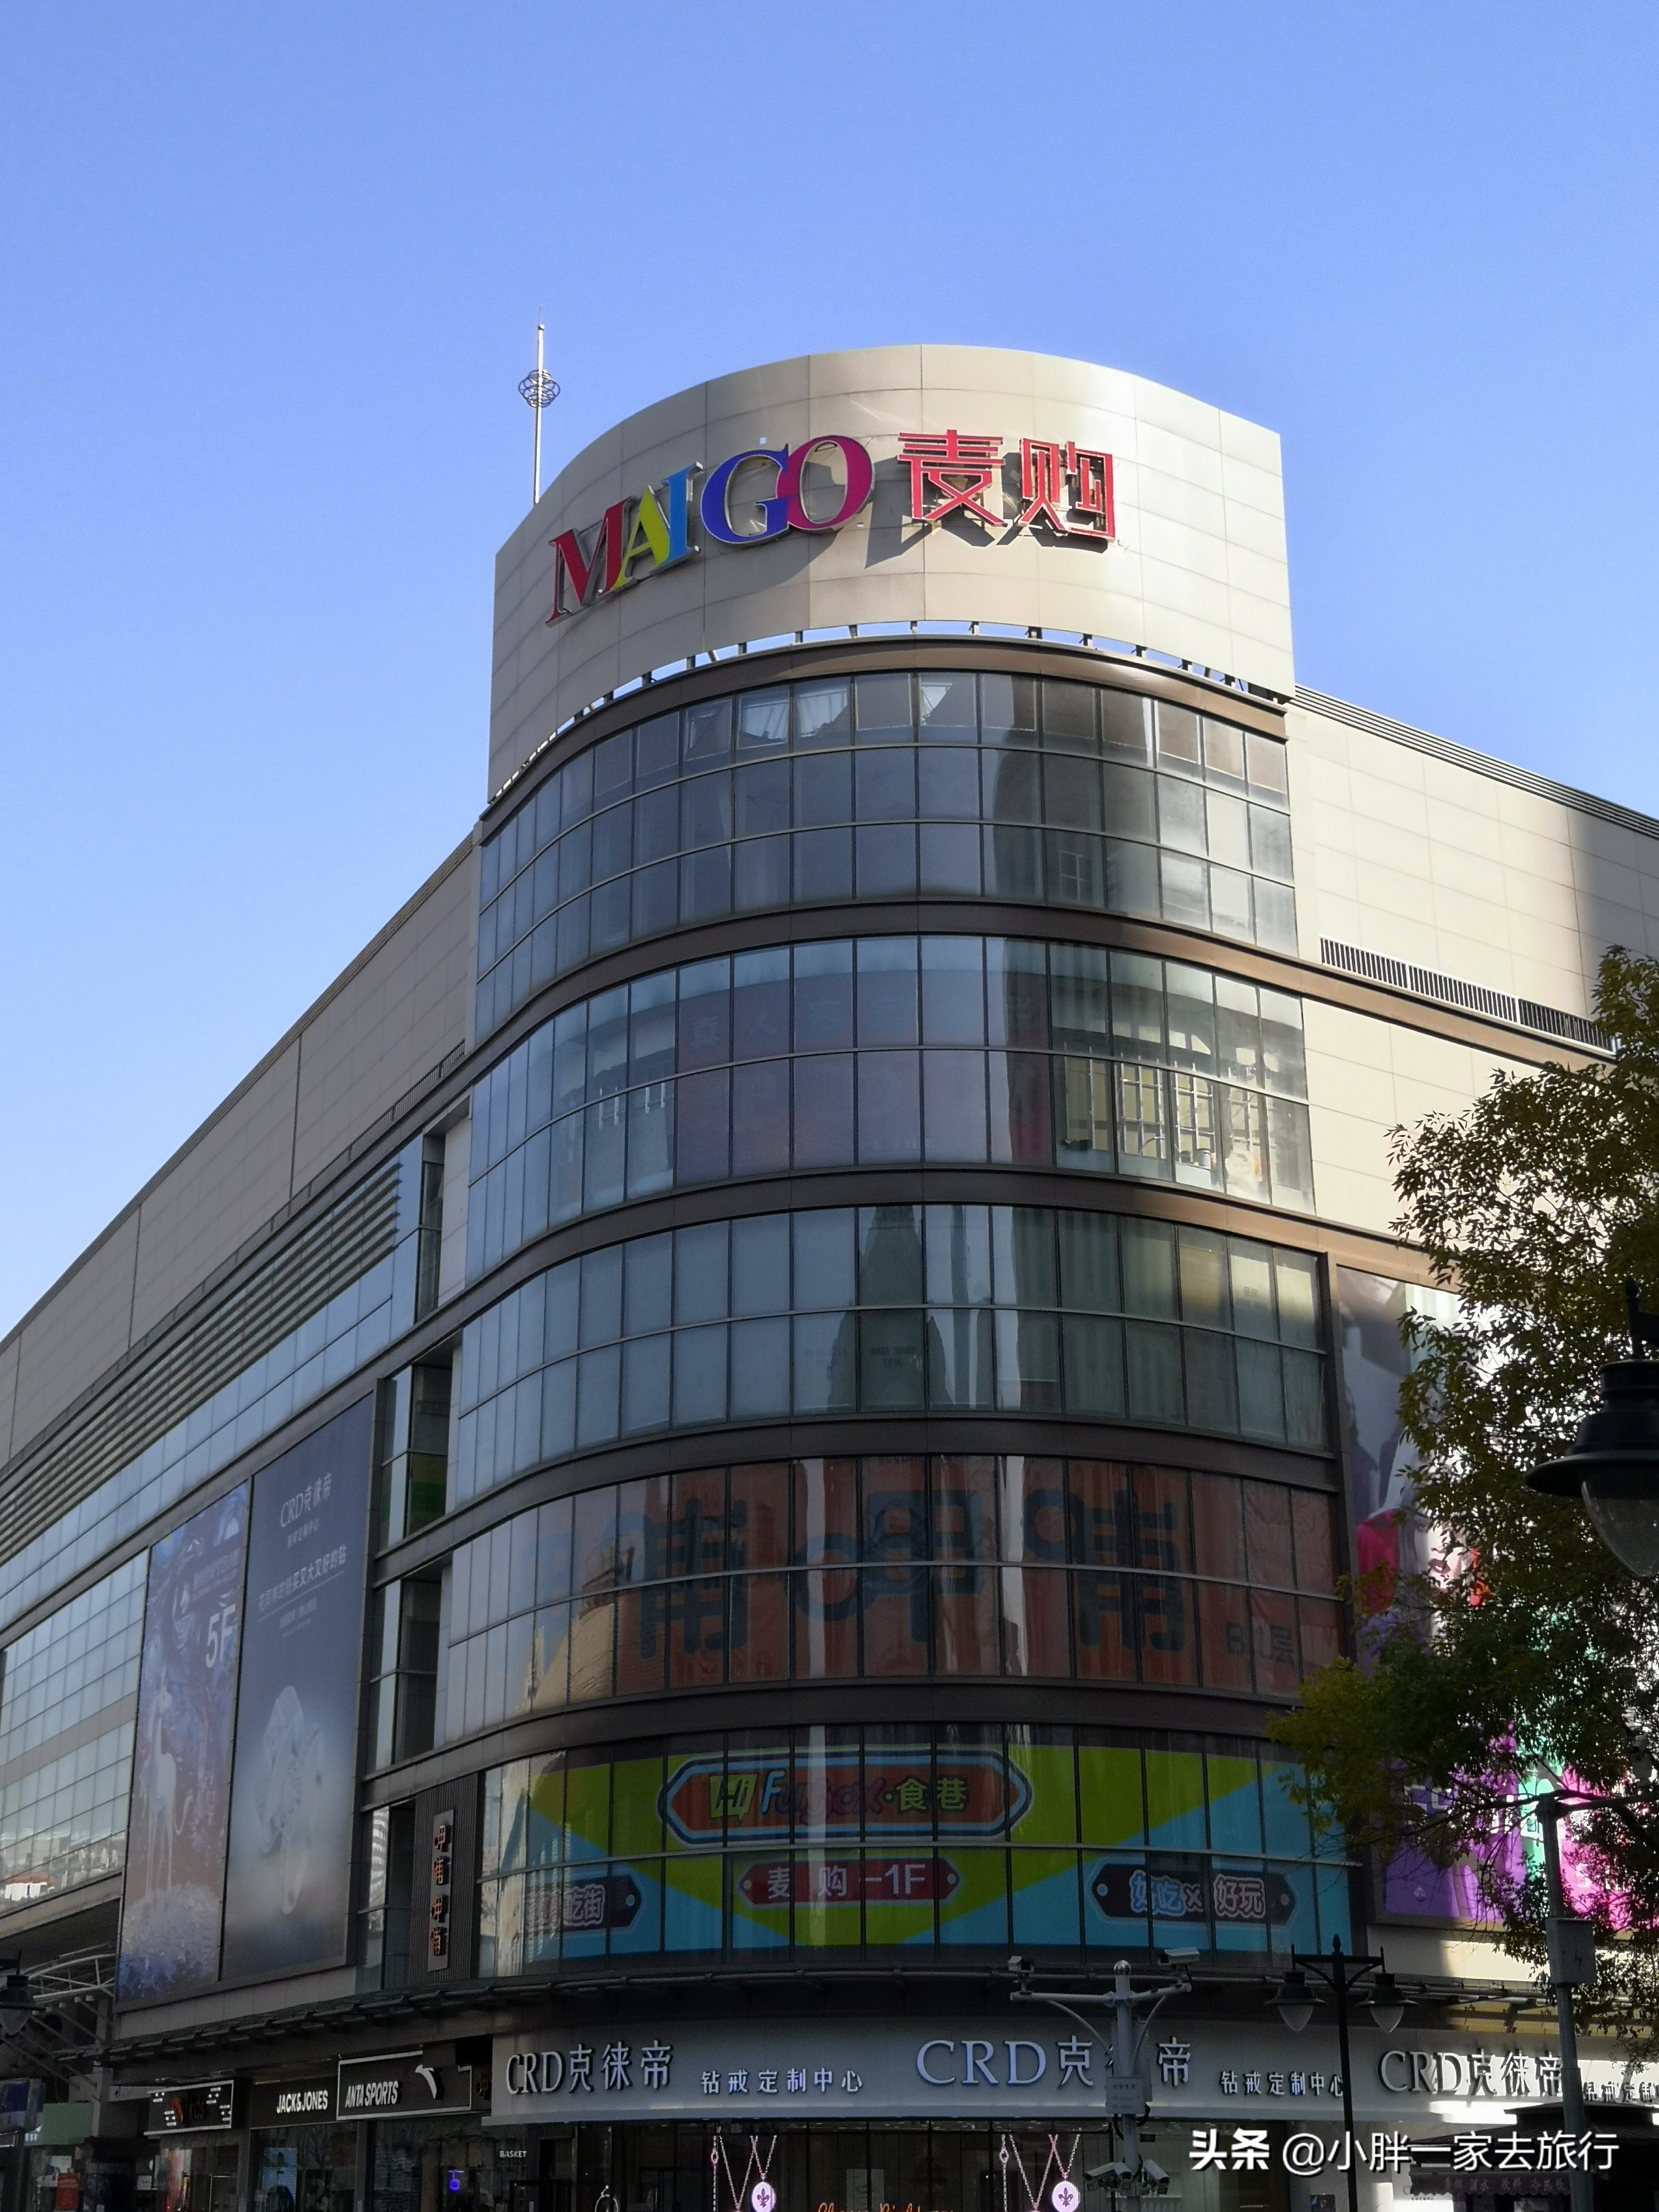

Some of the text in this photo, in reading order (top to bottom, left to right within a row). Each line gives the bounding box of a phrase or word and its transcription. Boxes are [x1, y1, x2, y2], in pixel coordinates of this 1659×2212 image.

[546, 429, 1117, 627] MAIGO 麦购
[205, 1603, 237, 1669] 5F
[767, 1865, 847, 1899] 麦购
[506, 2039, 673, 2095] CRD克徕帝
[916, 2035, 1191, 2088] CRD克帝
[345, 2080, 399, 2108] ANTA SPORTS
[700, 2067, 864, 2095] 钻戒定制中心
[1220, 2070, 1344, 2098] 钻戒定制中心
[276, 2090, 328, 2114] JACK&JONES
[499, 2150, 527, 2158] BASKET
